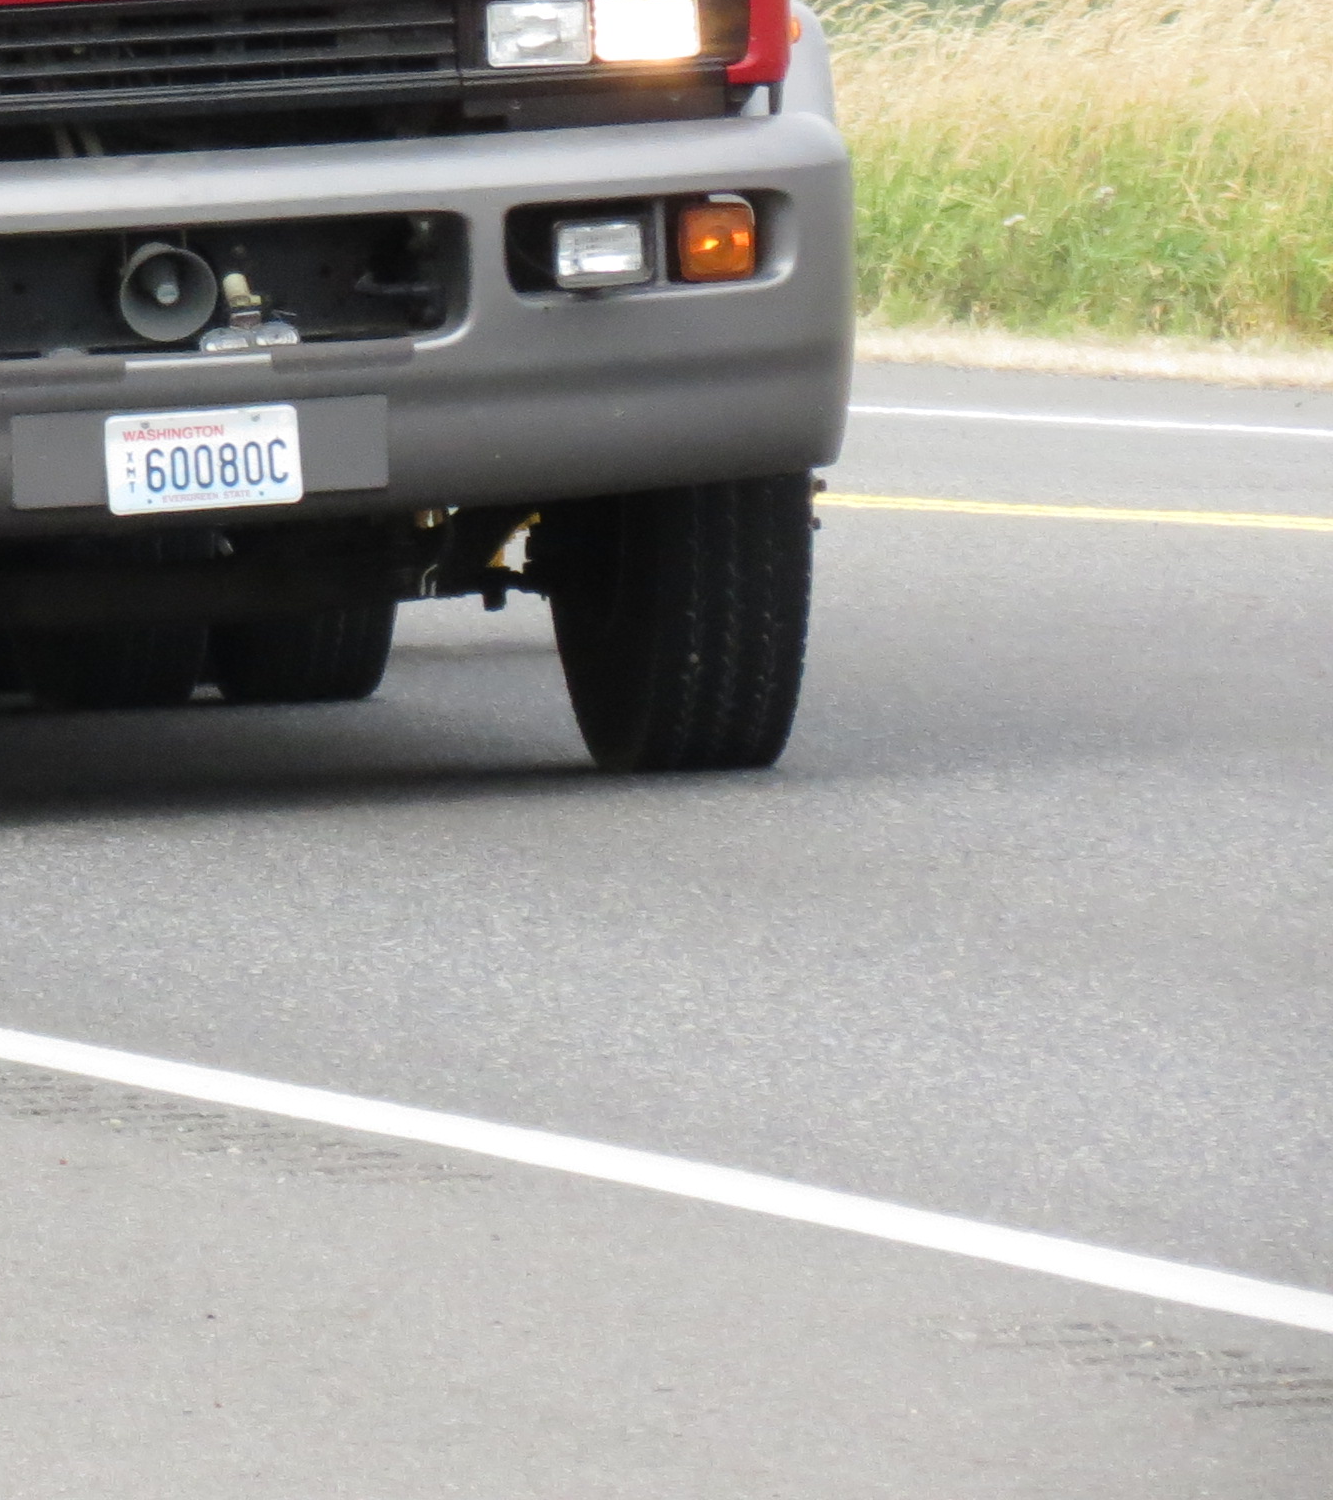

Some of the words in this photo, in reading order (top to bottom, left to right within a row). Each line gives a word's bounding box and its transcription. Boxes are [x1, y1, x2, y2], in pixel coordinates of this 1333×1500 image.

[122, 424, 224, 443] WASHINGTON
[145, 437, 289, 493] 60080C
[162, 491, 219, 504] EVERGREEN
[222, 489, 251, 501] STATE
